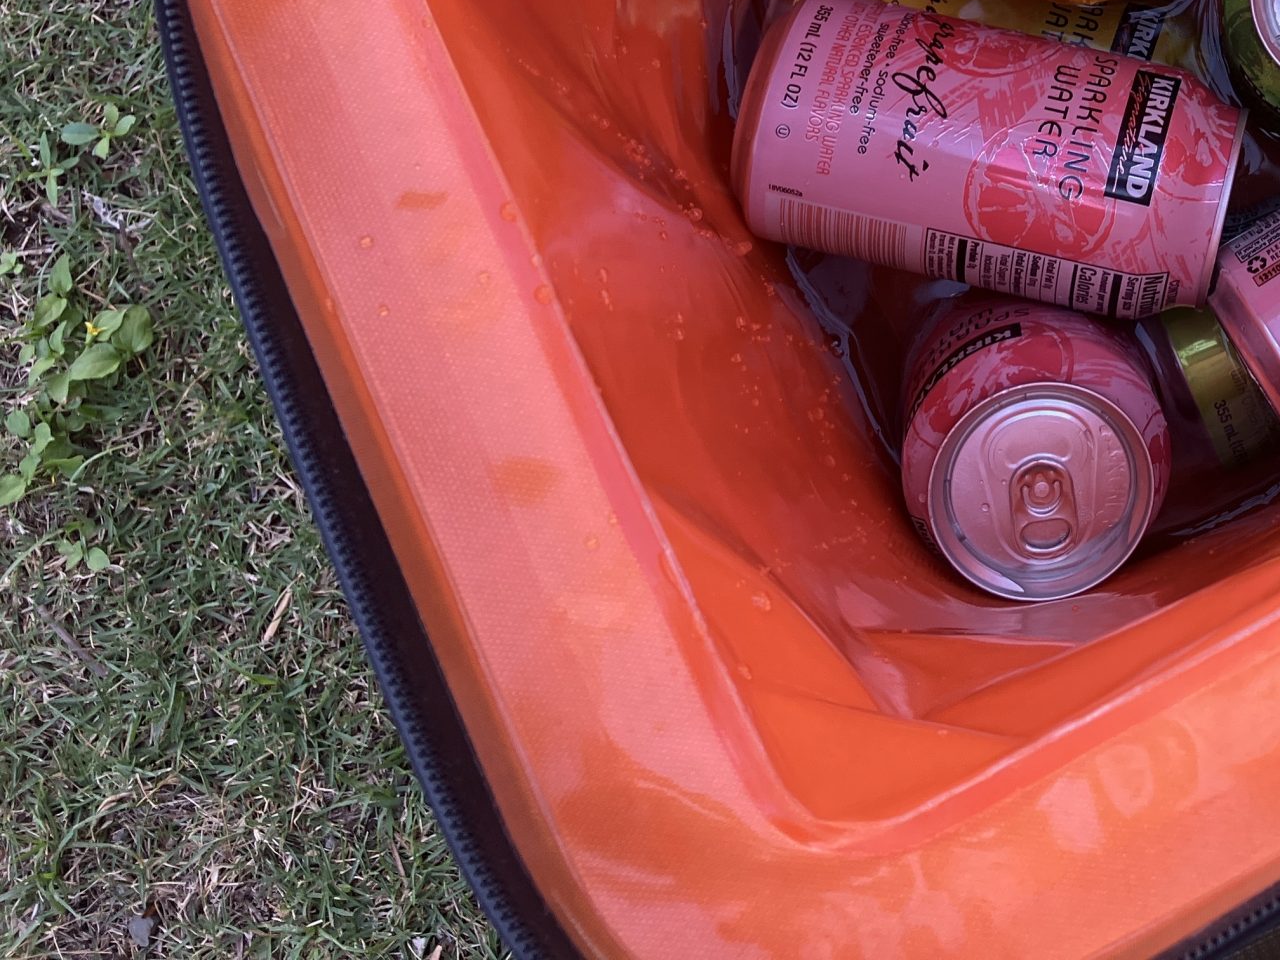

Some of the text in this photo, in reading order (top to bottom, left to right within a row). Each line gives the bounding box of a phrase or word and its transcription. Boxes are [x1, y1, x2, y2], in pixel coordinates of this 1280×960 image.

[835, 14, 858, 42] OTHER
[844, 22, 872, 68] ESSENCED
[779, 4, 833, 109] 355 mL (12 FL OZ)
[818, 41, 846, 88] NATURAL
[847, 22, 890, 115] sweetener-free
[803, 88, 830, 142] FLAVORS
[823, 68, 855, 133] SPARKLING
[854, 69, 890, 156] sodium-free
[891, 14, 954, 182] grapefruit
[1030, 62, 1080, 161] WATER
[815, 134, 837, 176] WATER
[1054, 53, 1118, 203] SPARKLING
[1111, 72, 1153, 192] Signature
[1125, 77, 1175, 198] KIRKLAND
[1015, 252, 1025, 267] Total
[1029, 254, 1041, 277] Sodium
[1046, 259, 1055, 274] Total
[1075, 268, 1097, 304] Calories
[1212, 398, 1232, 424] 355
